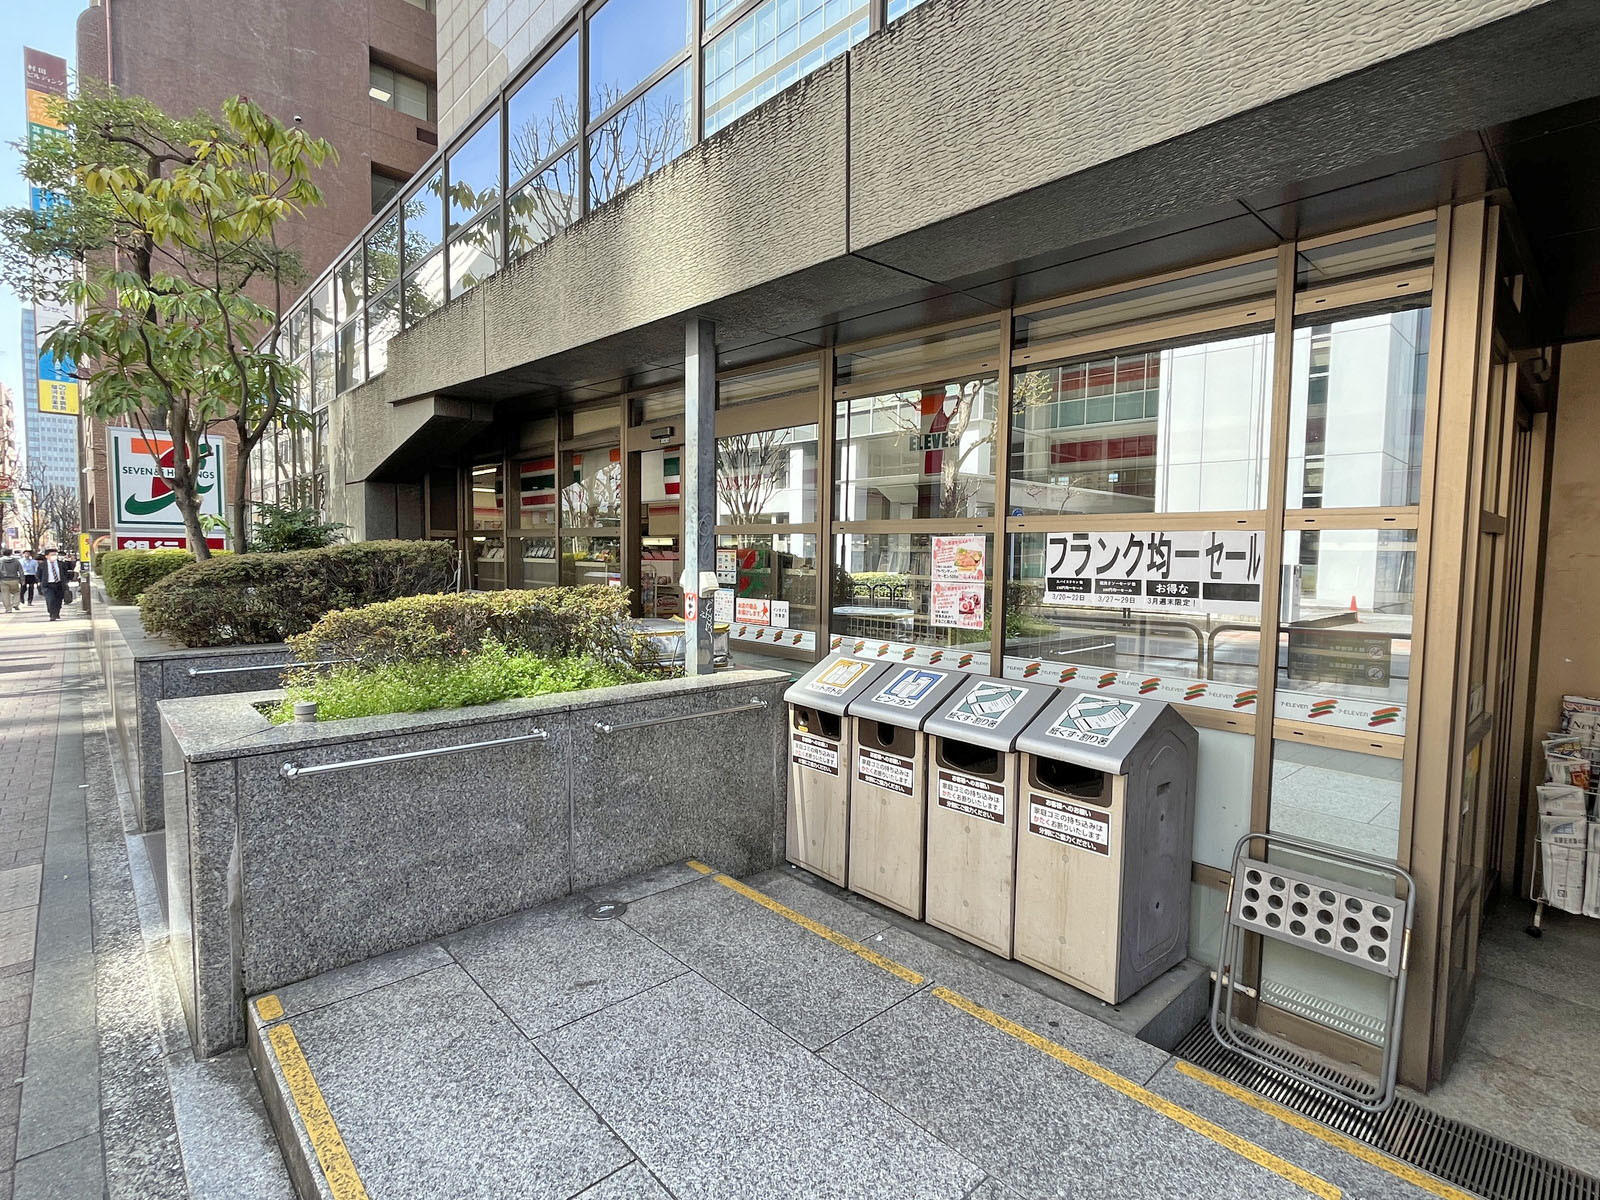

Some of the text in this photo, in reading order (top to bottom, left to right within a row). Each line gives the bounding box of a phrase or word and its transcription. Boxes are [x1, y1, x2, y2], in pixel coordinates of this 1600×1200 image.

[167, 469, 215, 479] HNGS
[1050, 532, 1260, 581] フランク均一セール
[1155, 583, 1189, 595] お得な
[1033, 806, 1103, 832] 家庭ゴミの持ち込みは
